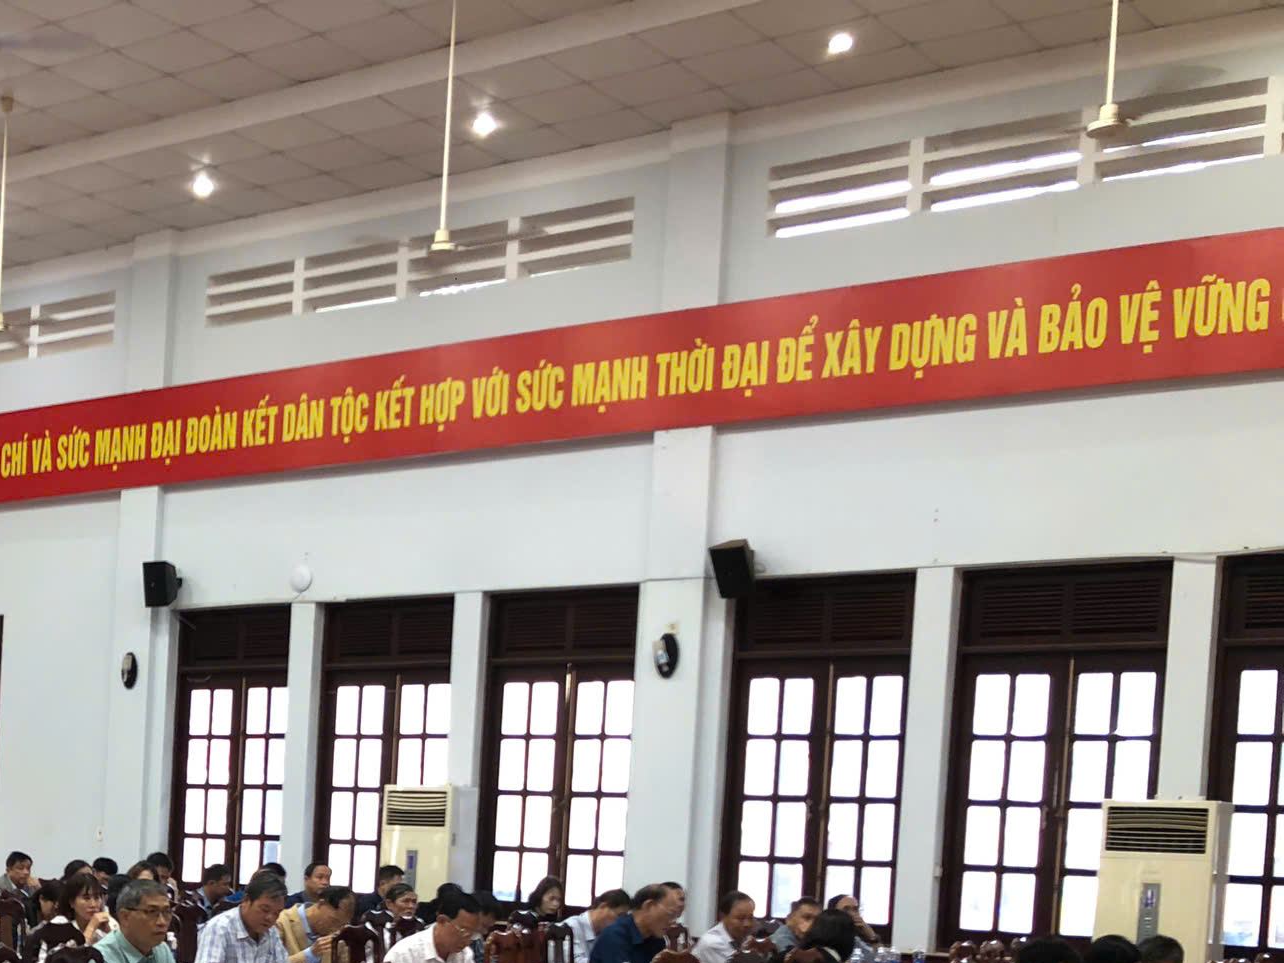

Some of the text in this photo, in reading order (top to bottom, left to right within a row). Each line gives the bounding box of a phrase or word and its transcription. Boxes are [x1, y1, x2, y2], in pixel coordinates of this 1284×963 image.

[1, 433, 28, 478] CHÍ
[32, 429, 52, 474] VÀ
[56, 425, 91, 471] SỨC
[94, 423, 148, 472] MẠNH
[150, 418, 182, 466] ĐẠI
[185, 405, 238, 455] ĐOÀN
[241, 393, 280, 448] KẾT
[281, 391, 326, 443] DÂN
[329, 386, 370, 444] TỘC
[373, 375, 416, 432] KẾT
[418, 375, 468, 433] HỢP
[471, 365, 511, 420] VỚI
[514, 359, 566, 414] SỨC
[570, 354, 650, 414] MẠNH
[654, 337, 716, 398] THỜI
[720, 339, 772, 398] ĐẠI
[775, 313, 820, 385] ĐỂ
[819, 318, 884, 380] XÂY
[888, 312, 979, 380] DỰNG
[986, 295, 1029, 360] VÀ
[1037, 282, 1109, 355] BẢO
[1119, 279, 1163, 355] VỆ
[1172, 273, 1272, 340] VỮNG
